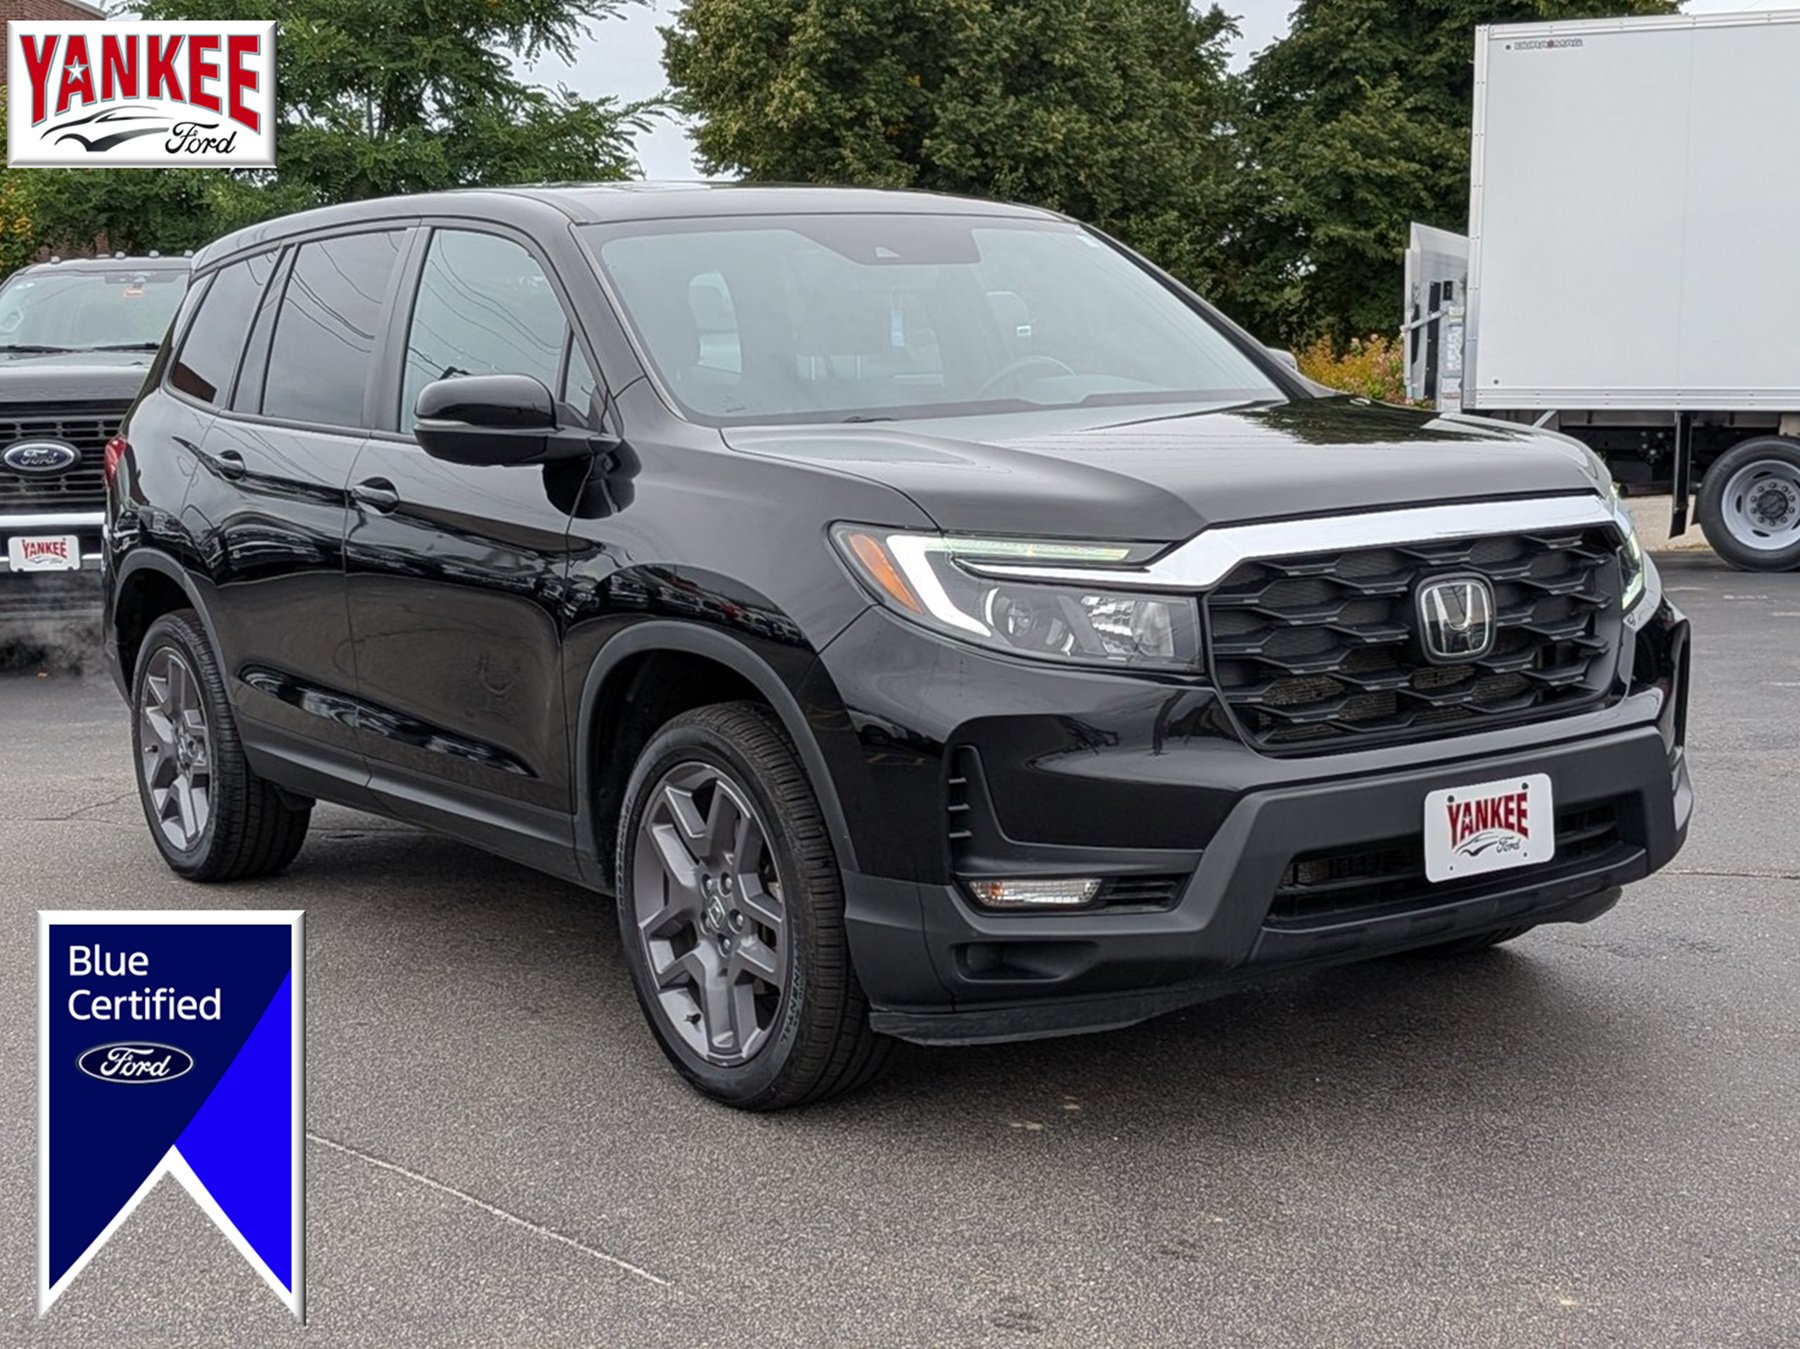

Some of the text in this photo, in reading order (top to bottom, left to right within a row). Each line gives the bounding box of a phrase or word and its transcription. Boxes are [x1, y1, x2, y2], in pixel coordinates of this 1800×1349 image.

[20, 448, 58, 465] Ford
[22, 541, 68, 559] YANKEE
[1447, 792, 1529, 849] YANKEE
[1496, 836, 1521, 853] Ford
